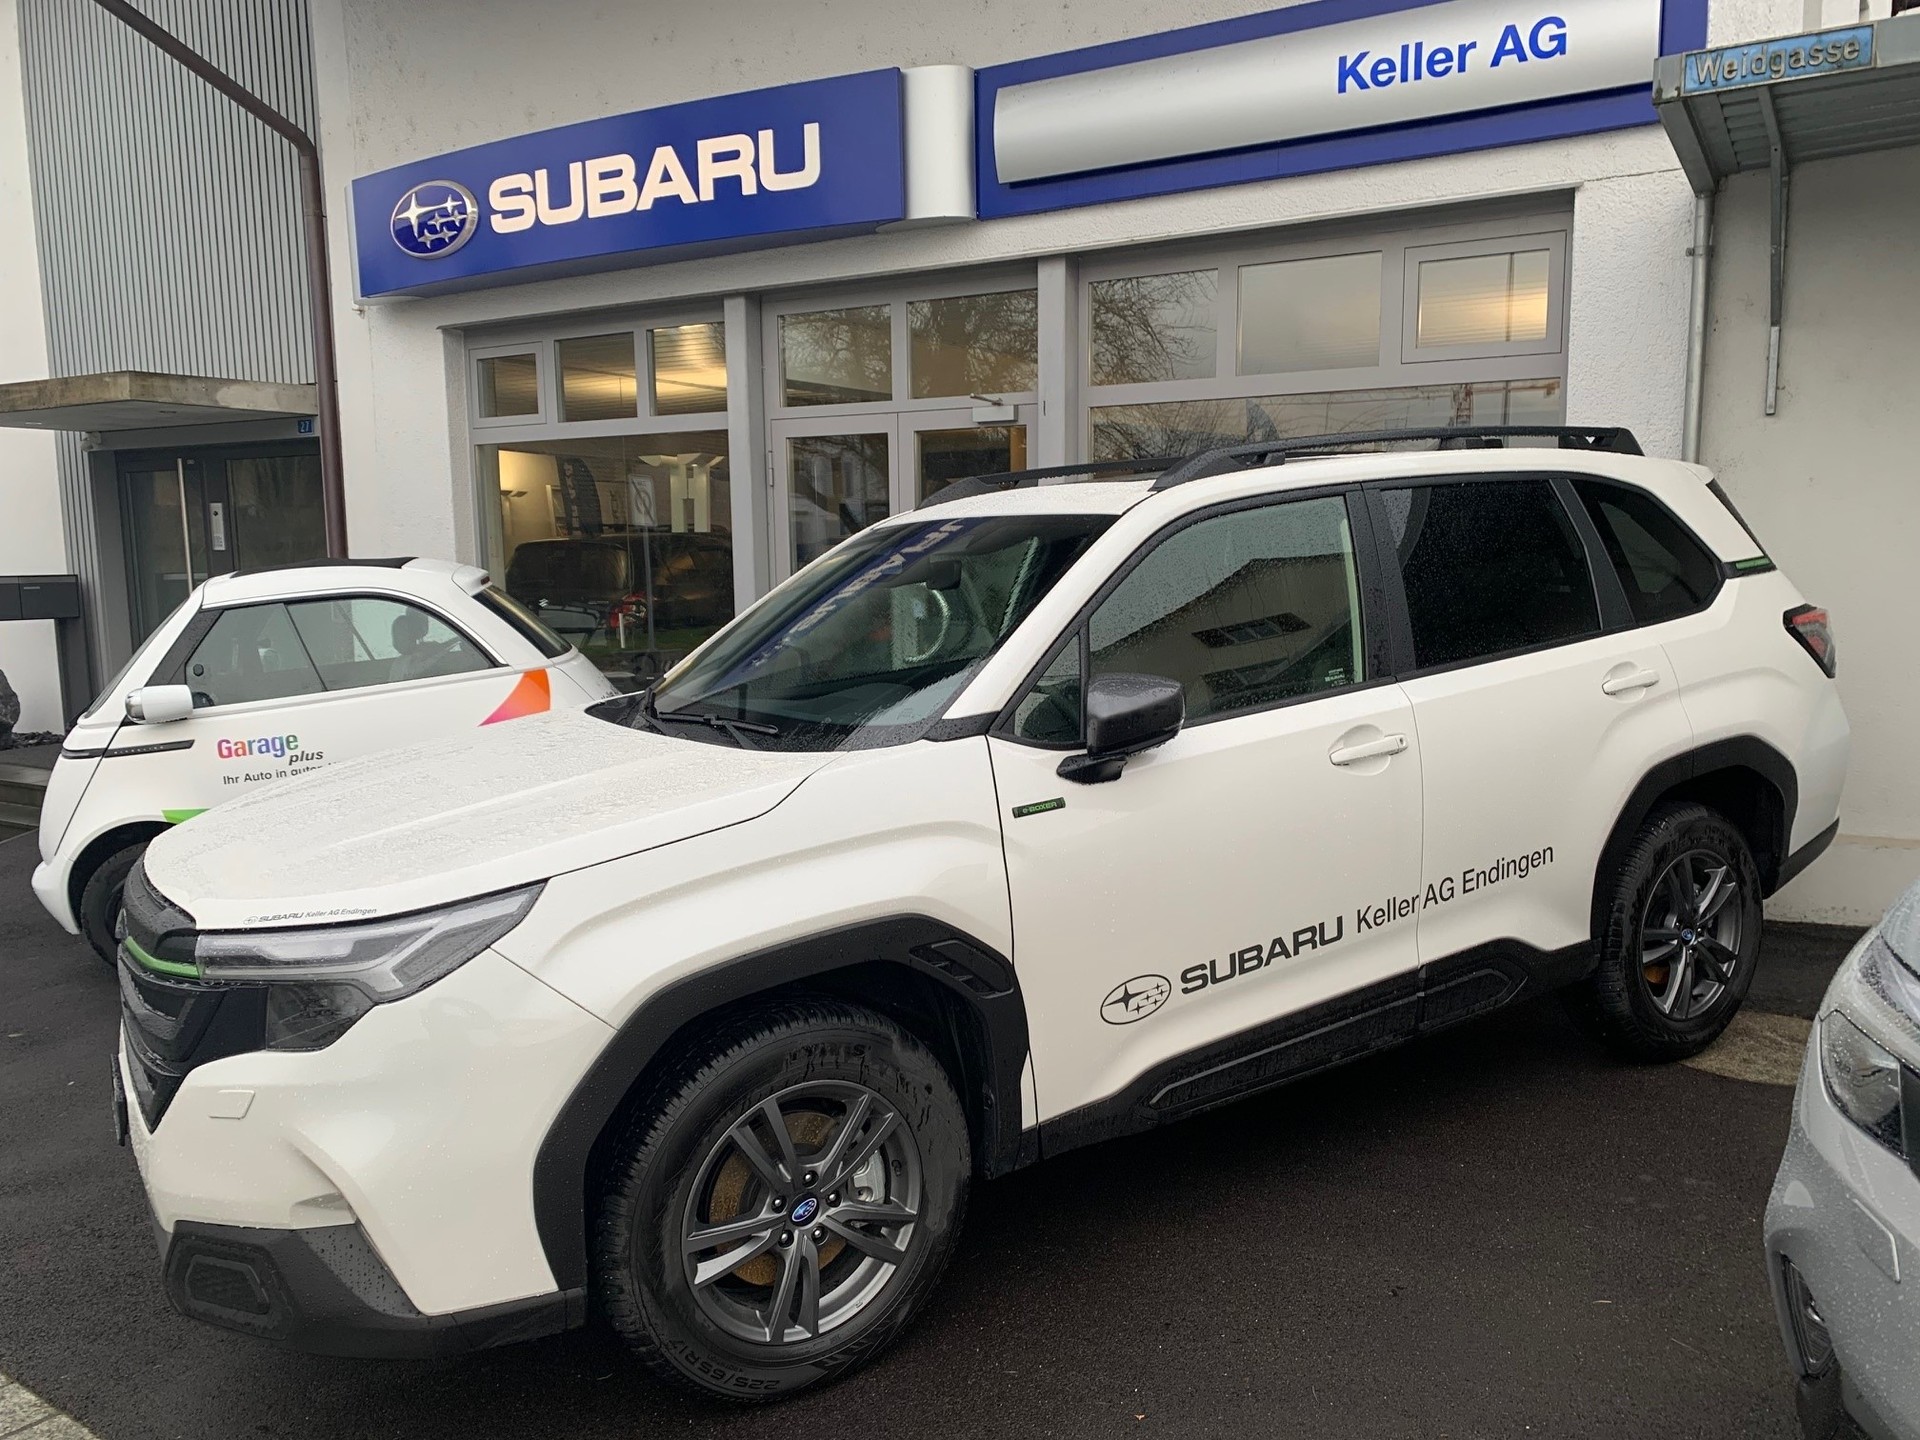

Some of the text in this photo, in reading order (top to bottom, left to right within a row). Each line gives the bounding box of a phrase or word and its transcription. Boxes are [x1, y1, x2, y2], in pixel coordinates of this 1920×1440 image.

[1337, 16, 1567, 94] Keller AG
[1695, 39, 1860, 86] Weidgasse
[488, 122, 821, 234] SUBARU
[217, 734, 299, 759] Garage
[289, 751, 324, 766] plus
[223, 775, 240, 785] Ihr
[243, 772, 272, 782] Auto
[275, 769, 287, 779] in
[258, 912, 304, 923] SUBARU
[304, 910, 327, 918] Keller
[340, 907, 377, 915] Endingen
[1180, 845, 1554, 995] SUBARU Keller AG Endingen
